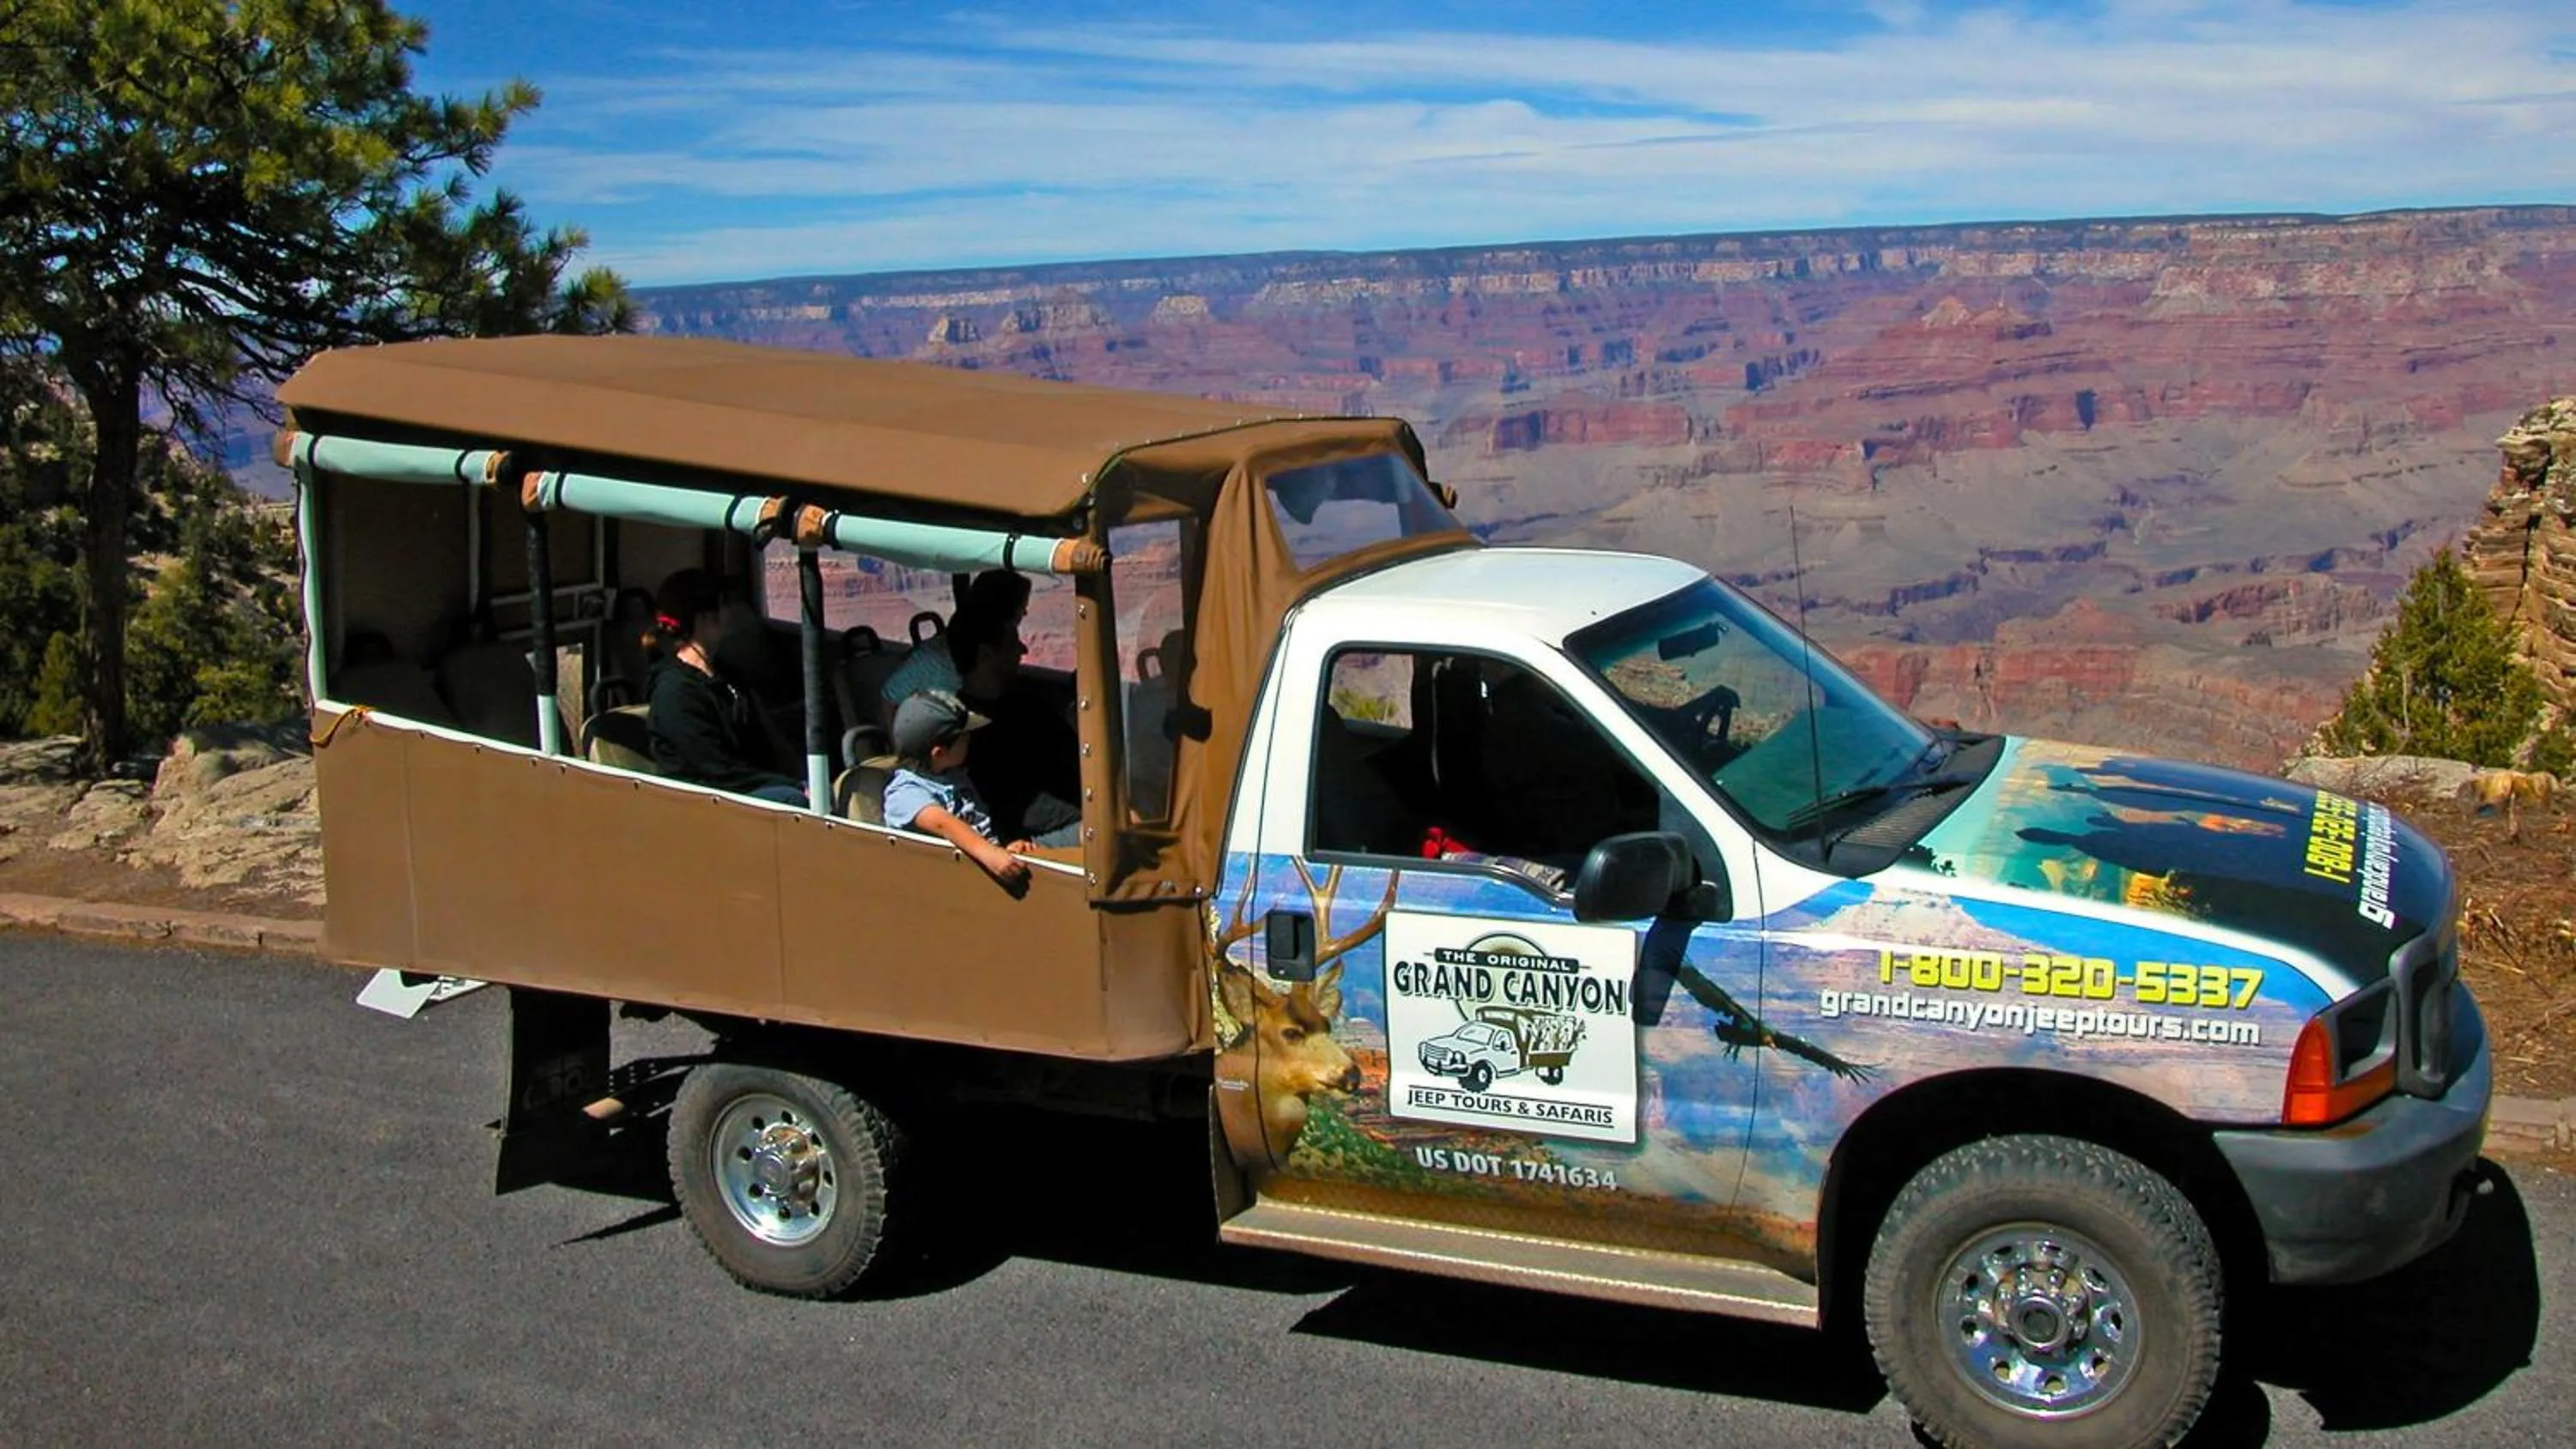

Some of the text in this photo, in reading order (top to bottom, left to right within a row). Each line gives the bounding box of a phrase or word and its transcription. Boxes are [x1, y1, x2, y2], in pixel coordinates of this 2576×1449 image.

[1442, 949, 1571, 972] THE ORIGINAL
[1878, 949, 2265, 1009] 1-800-320-5337
[1393, 960, 1628, 1016] GRAND CANYON
[1820, 987, 2261, 1046] grandcanyonjeeptours.com
[1406, 1088, 1613, 1125] JEEP TOURS & SAFARIS
[1415, 1146, 1619, 1192] US DOT 1741634
